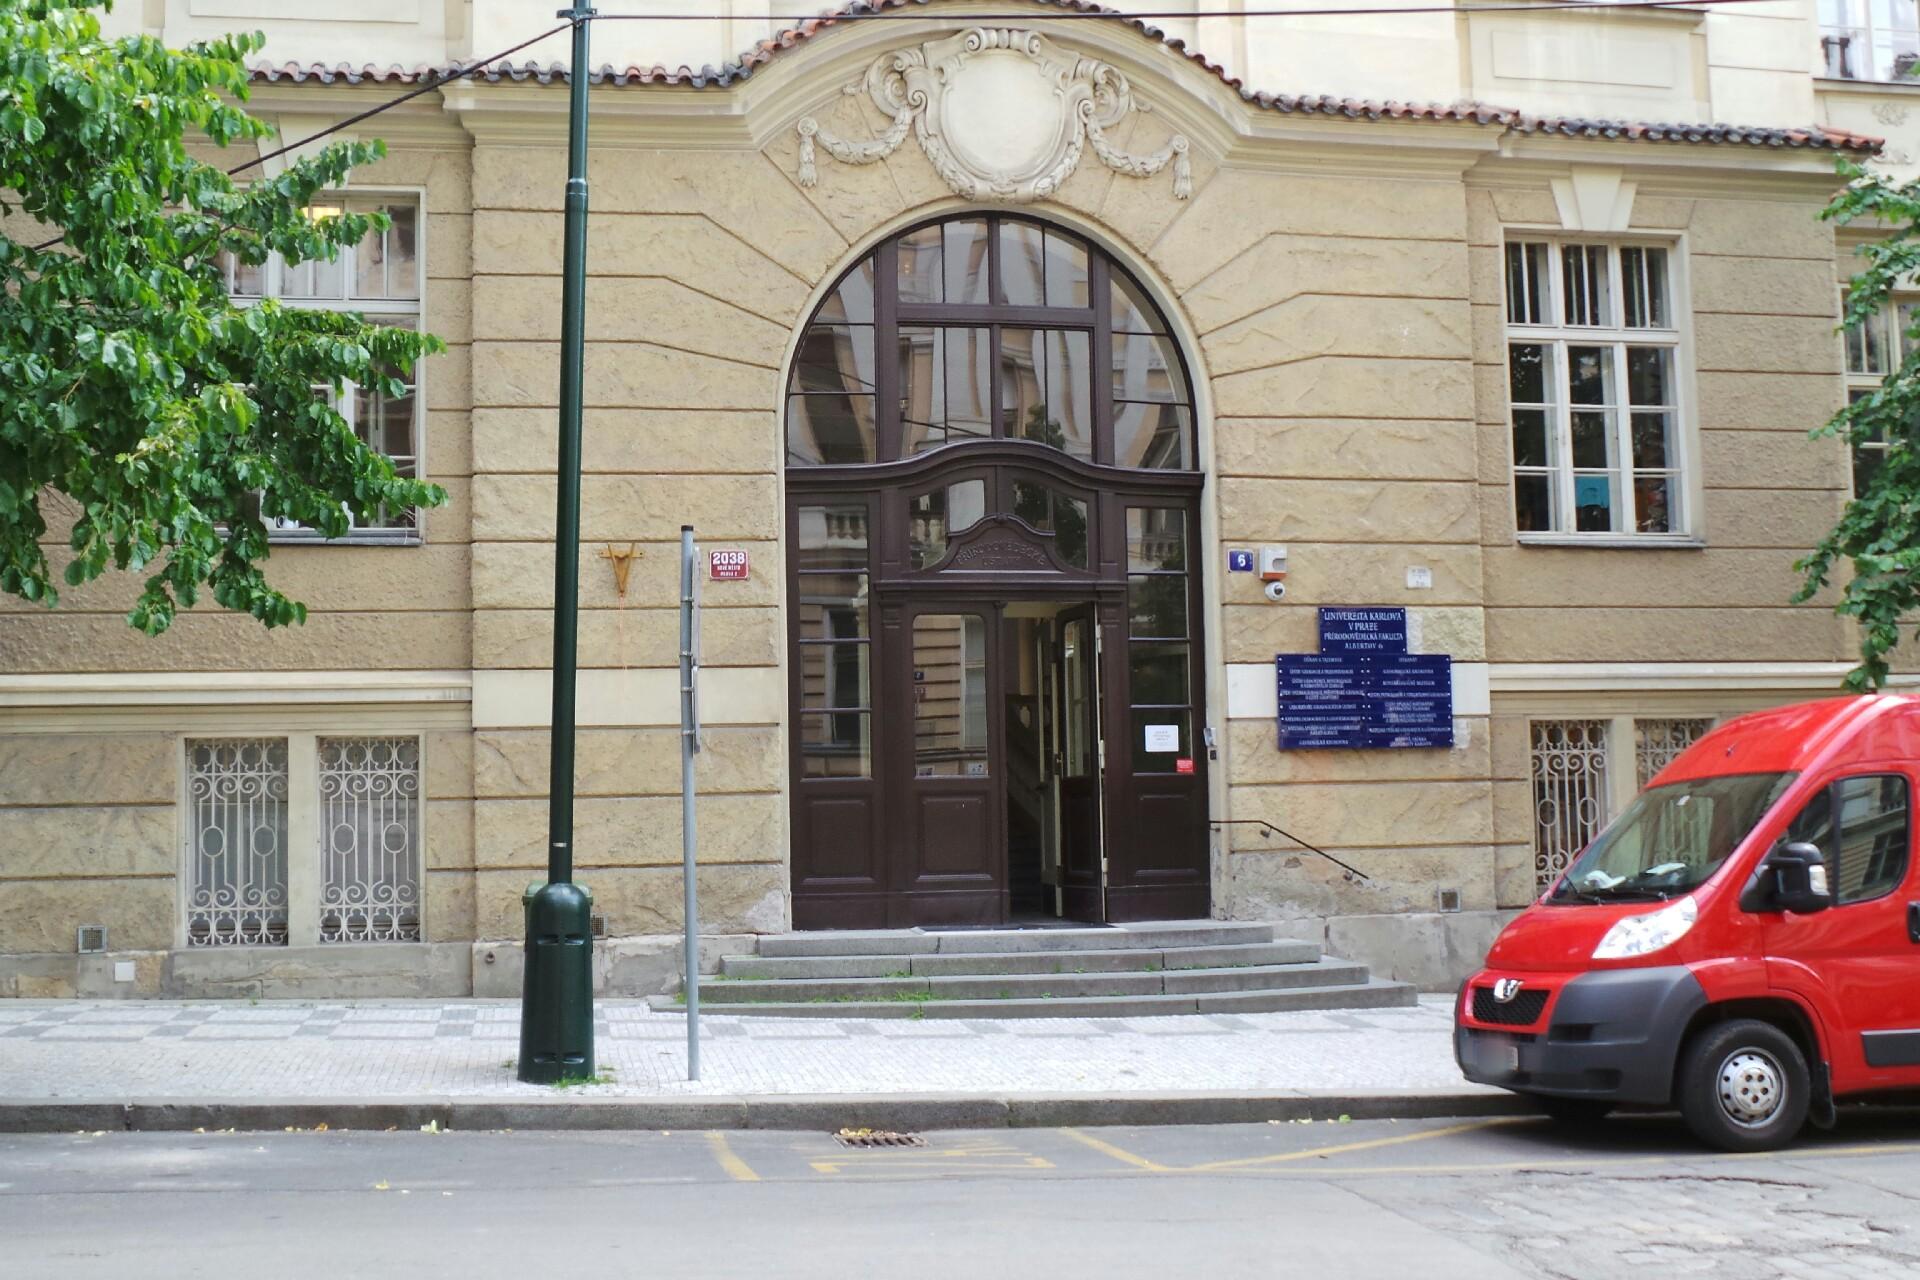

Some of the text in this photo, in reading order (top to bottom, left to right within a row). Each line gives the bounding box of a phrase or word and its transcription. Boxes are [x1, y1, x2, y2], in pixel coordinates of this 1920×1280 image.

[712, 552, 745, 565] 2038
[1237, 554, 1246, 567] 6
[1324, 611, 1402, 621] UNIVERZITA KARLOVA
[1348, 622, 1379, 631] V PRAZE
[1378, 632, 1404, 641] FAKULTA
